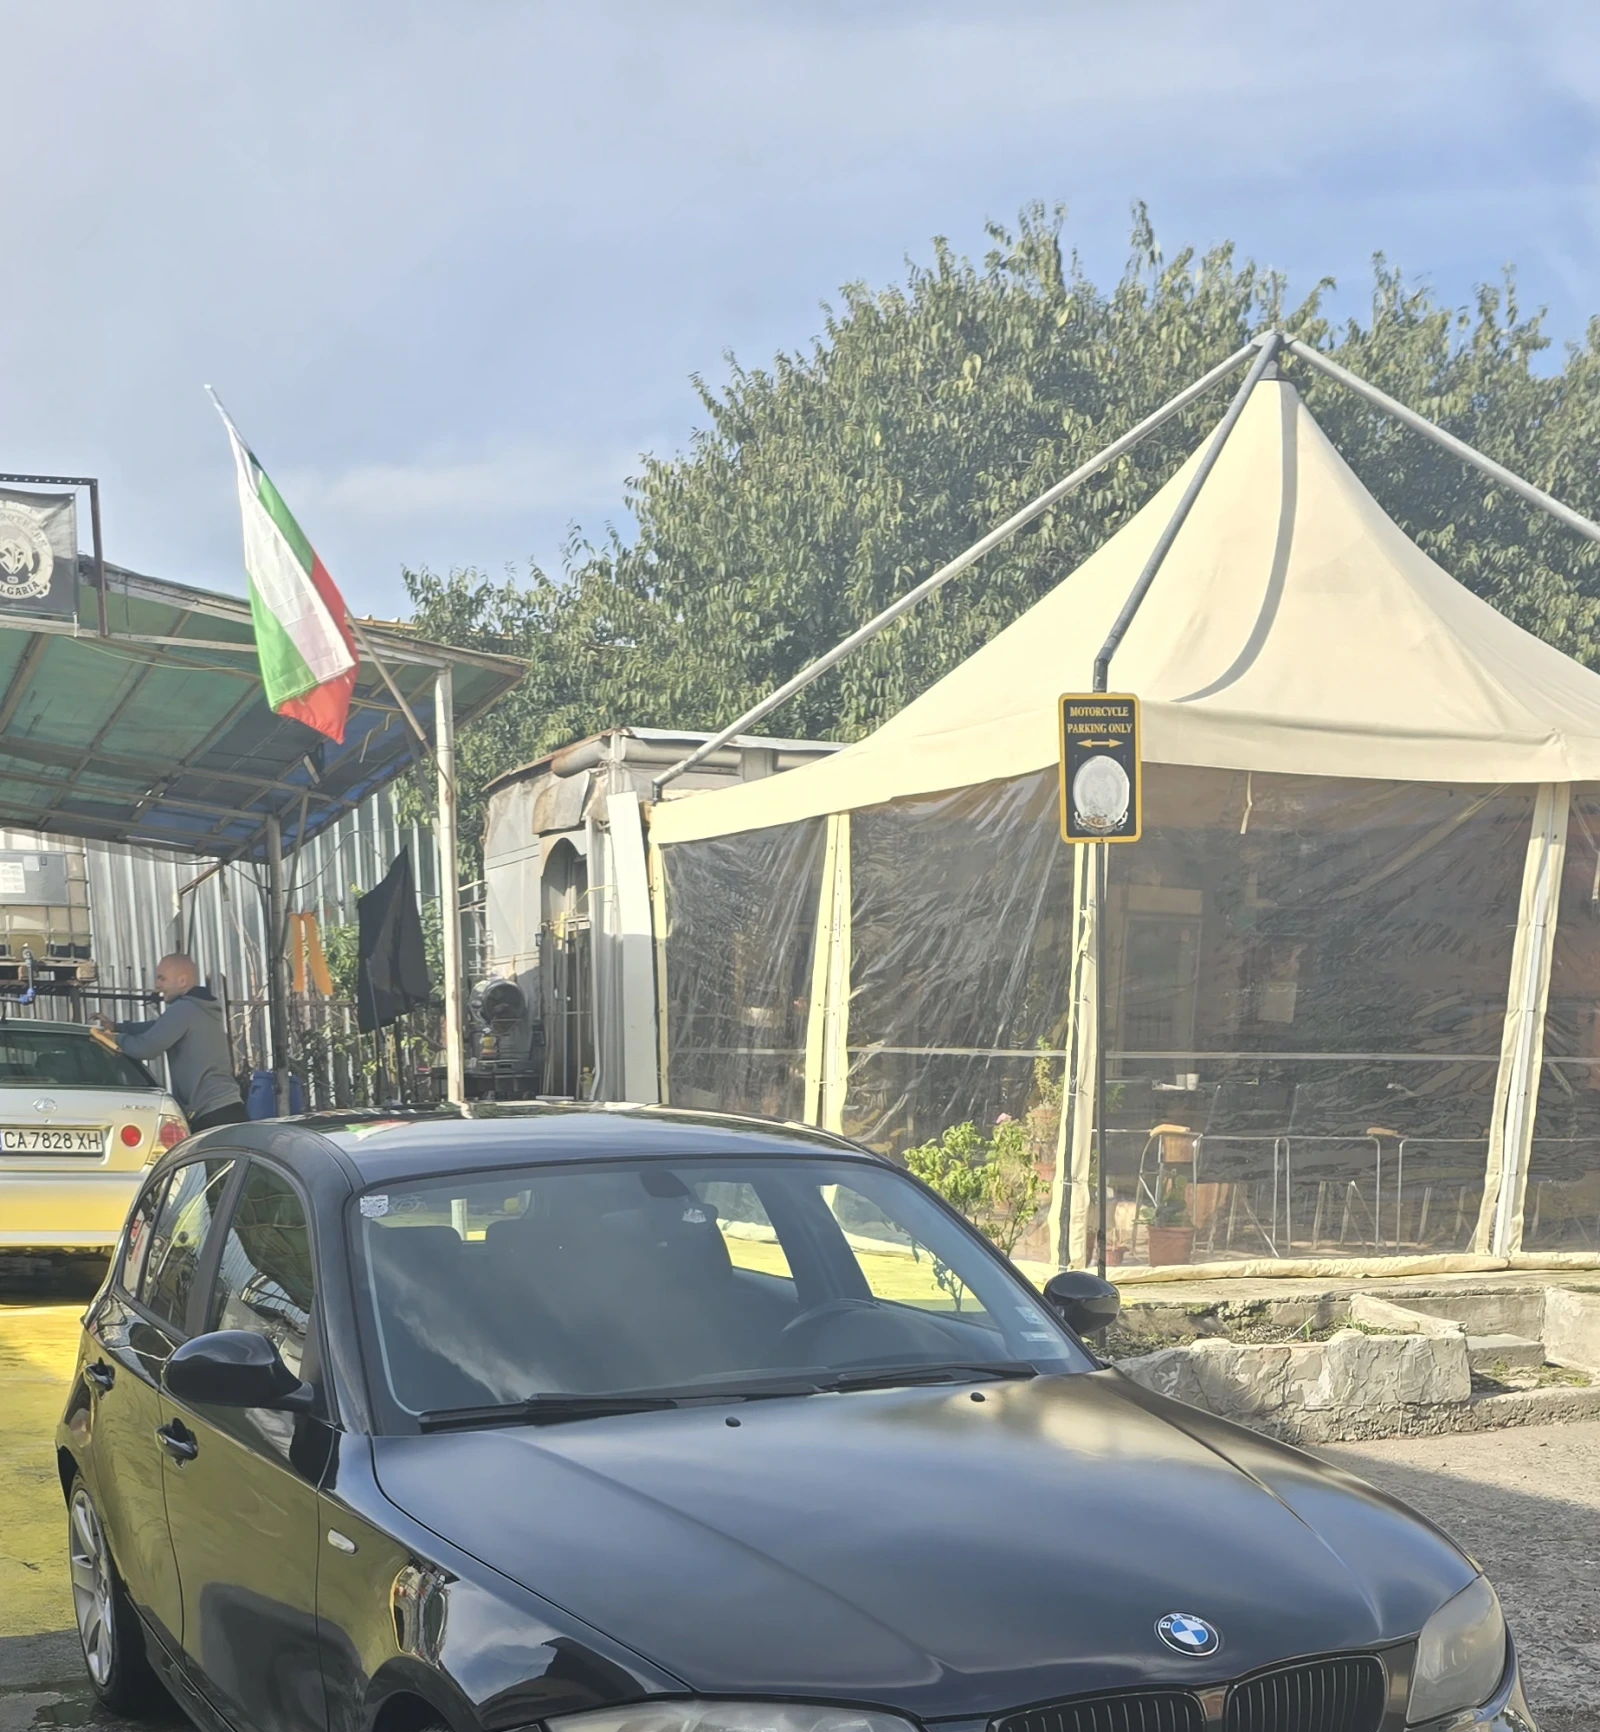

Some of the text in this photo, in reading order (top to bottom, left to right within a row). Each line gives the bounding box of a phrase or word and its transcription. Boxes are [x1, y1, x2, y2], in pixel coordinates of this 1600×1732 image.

[1069, 706, 1130, 717] MOTORCYCLE
[1067, 723, 1133, 734] PARKING ONLY
[4, 1131, 99, 1150] CA 7828 XH
[1160, 1613, 1203, 1629] BMW
